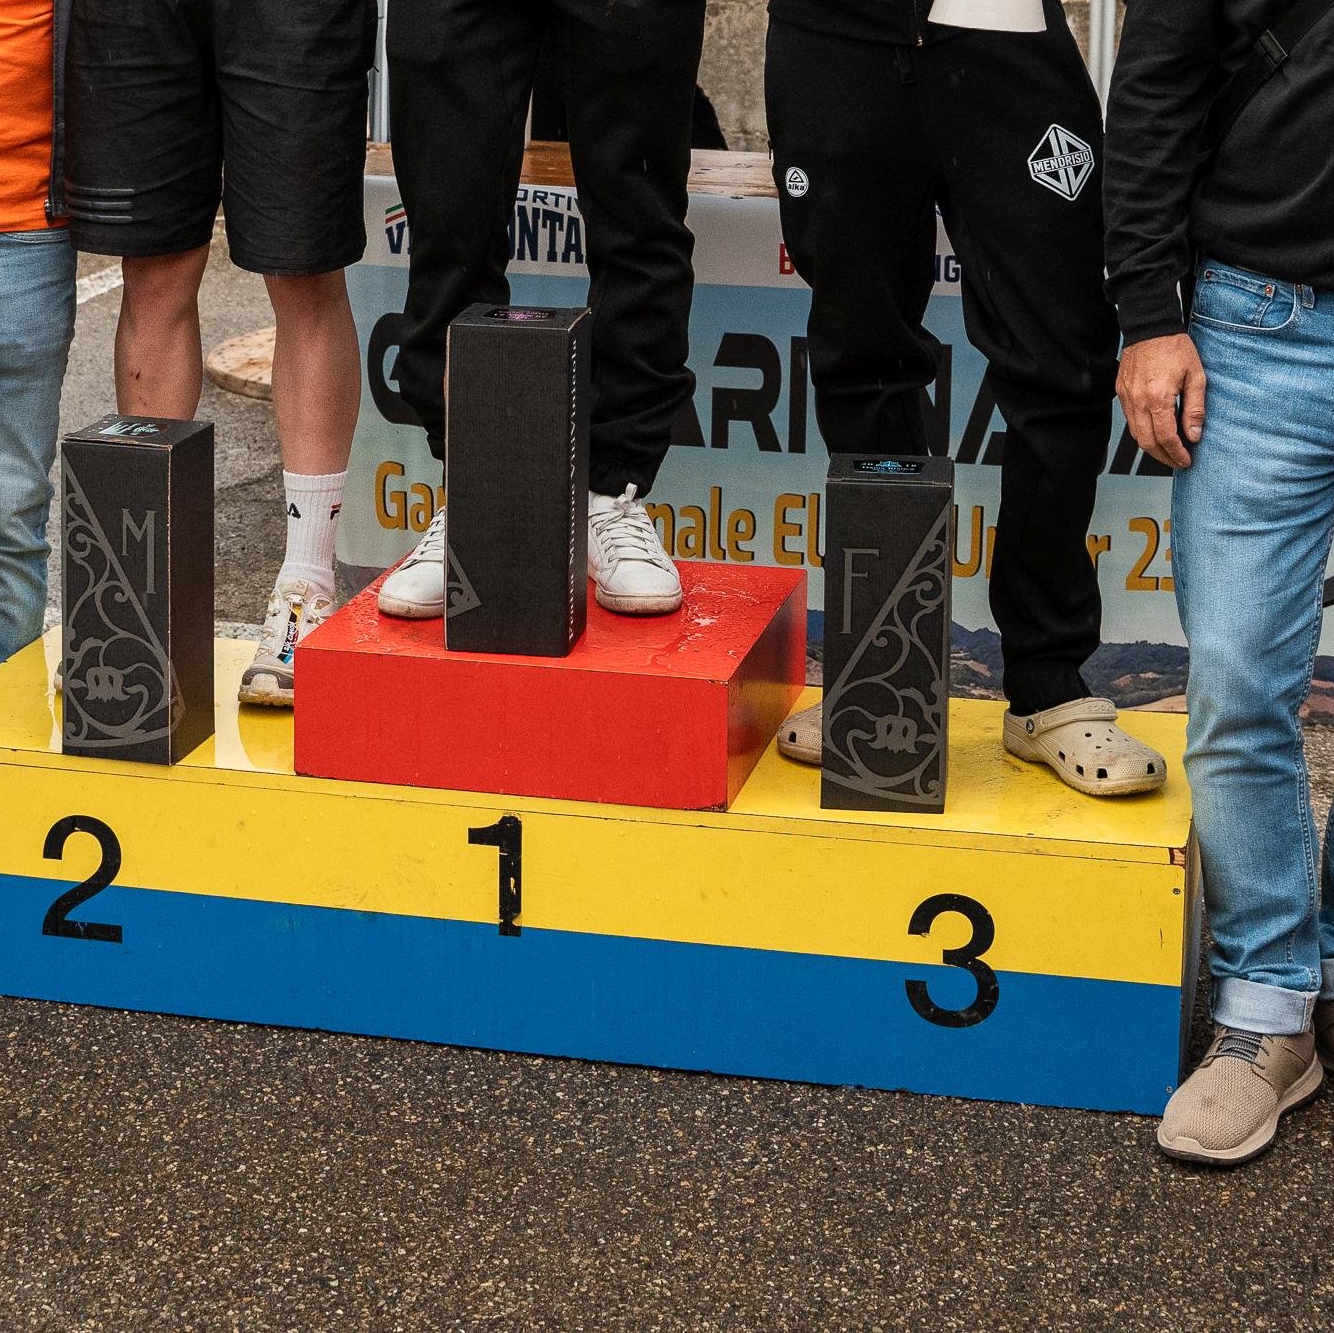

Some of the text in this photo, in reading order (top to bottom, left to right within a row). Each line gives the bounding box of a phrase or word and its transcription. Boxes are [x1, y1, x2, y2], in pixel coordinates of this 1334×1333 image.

[1032, 151, 1091, 174] MENDRISIO
[120, 507, 158, 595] M
[839, 547, 880, 635] F
[42, 814, 123, 944] 2
[468, 814, 522, 936] 1
[905, 892, 1000, 1028] 3
